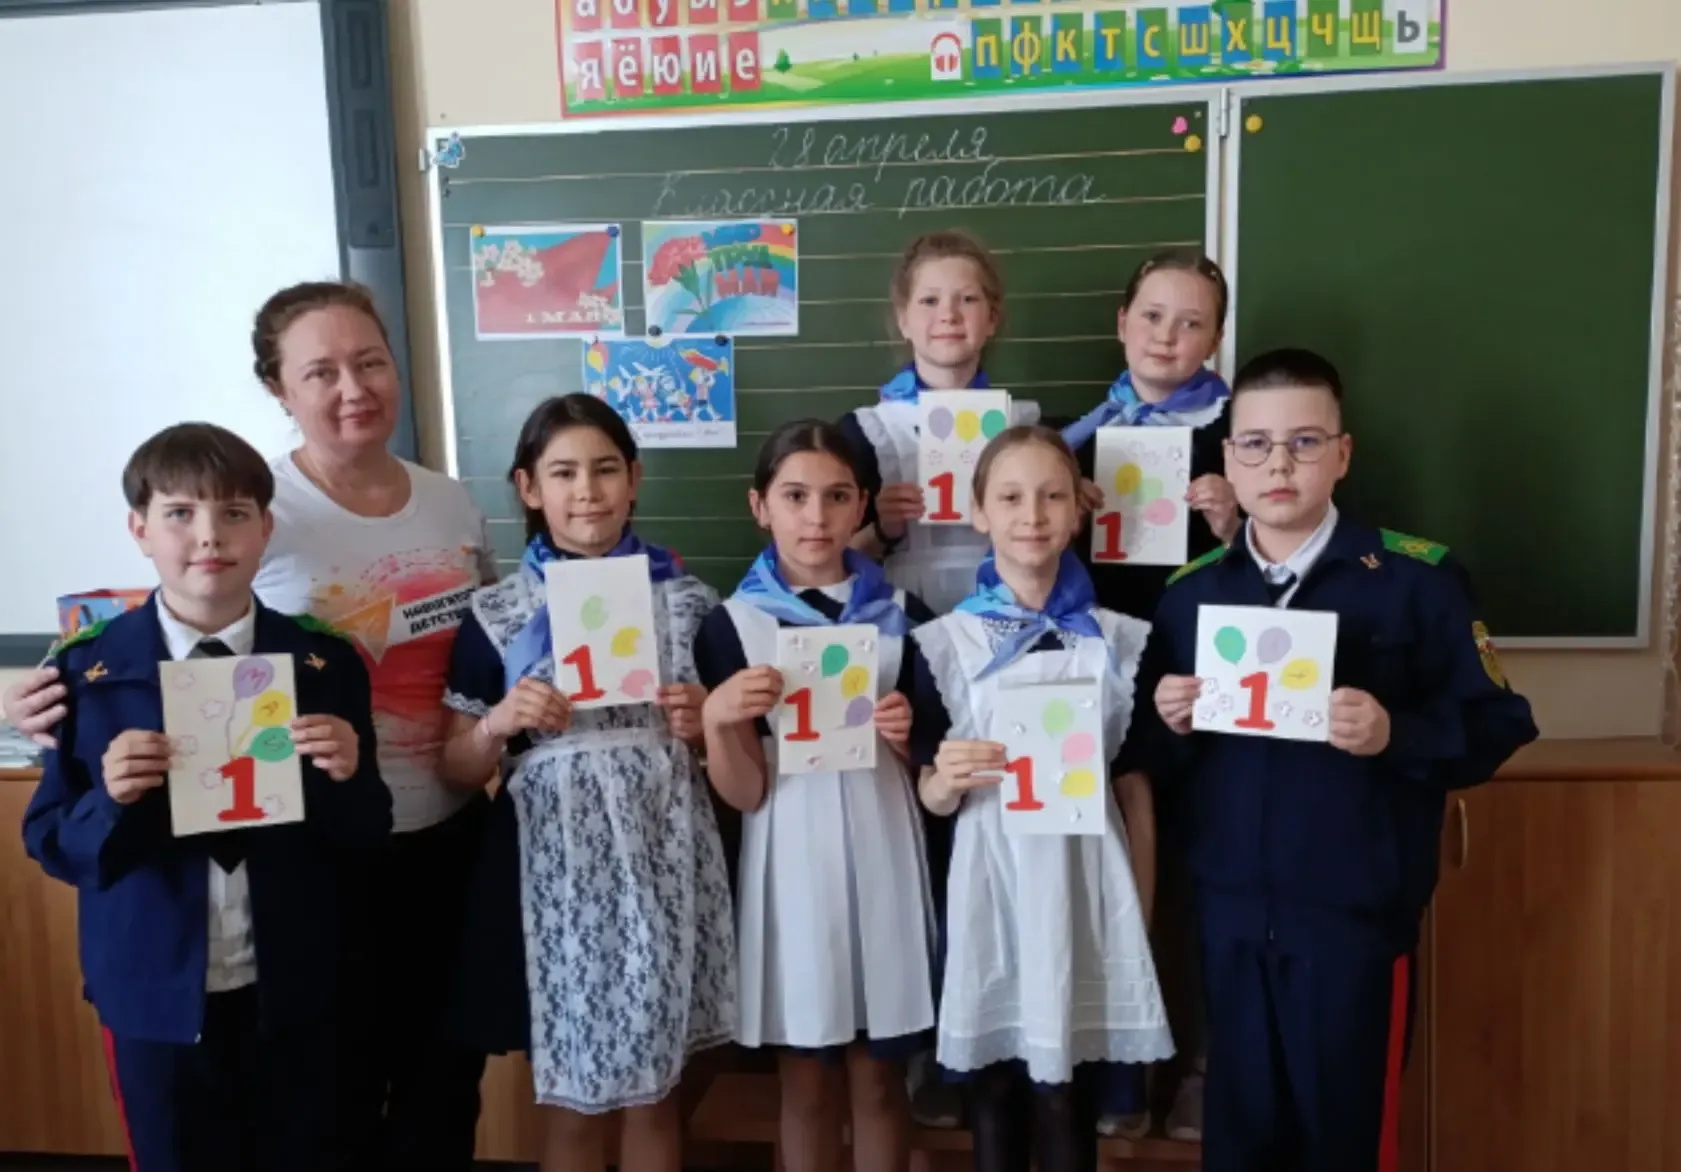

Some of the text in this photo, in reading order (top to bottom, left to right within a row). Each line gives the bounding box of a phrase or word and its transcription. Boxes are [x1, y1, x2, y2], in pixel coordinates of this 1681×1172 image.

[976, 10, 1421, 75] п ф к т с ш х ц ч щ ь
[768, 126, 996, 183] 28 апреля
[898, 158, 1107, 219] работа
[928, 471, 962, 520] 1
[1095, 511, 1127, 560] 1
[563, 644, 606, 702] 1
[1234, 671, 1275, 730] 1
[784, 687, 820, 741] 1
[217, 755, 268, 822] 1
[1005, 756, 1045, 811] 1
